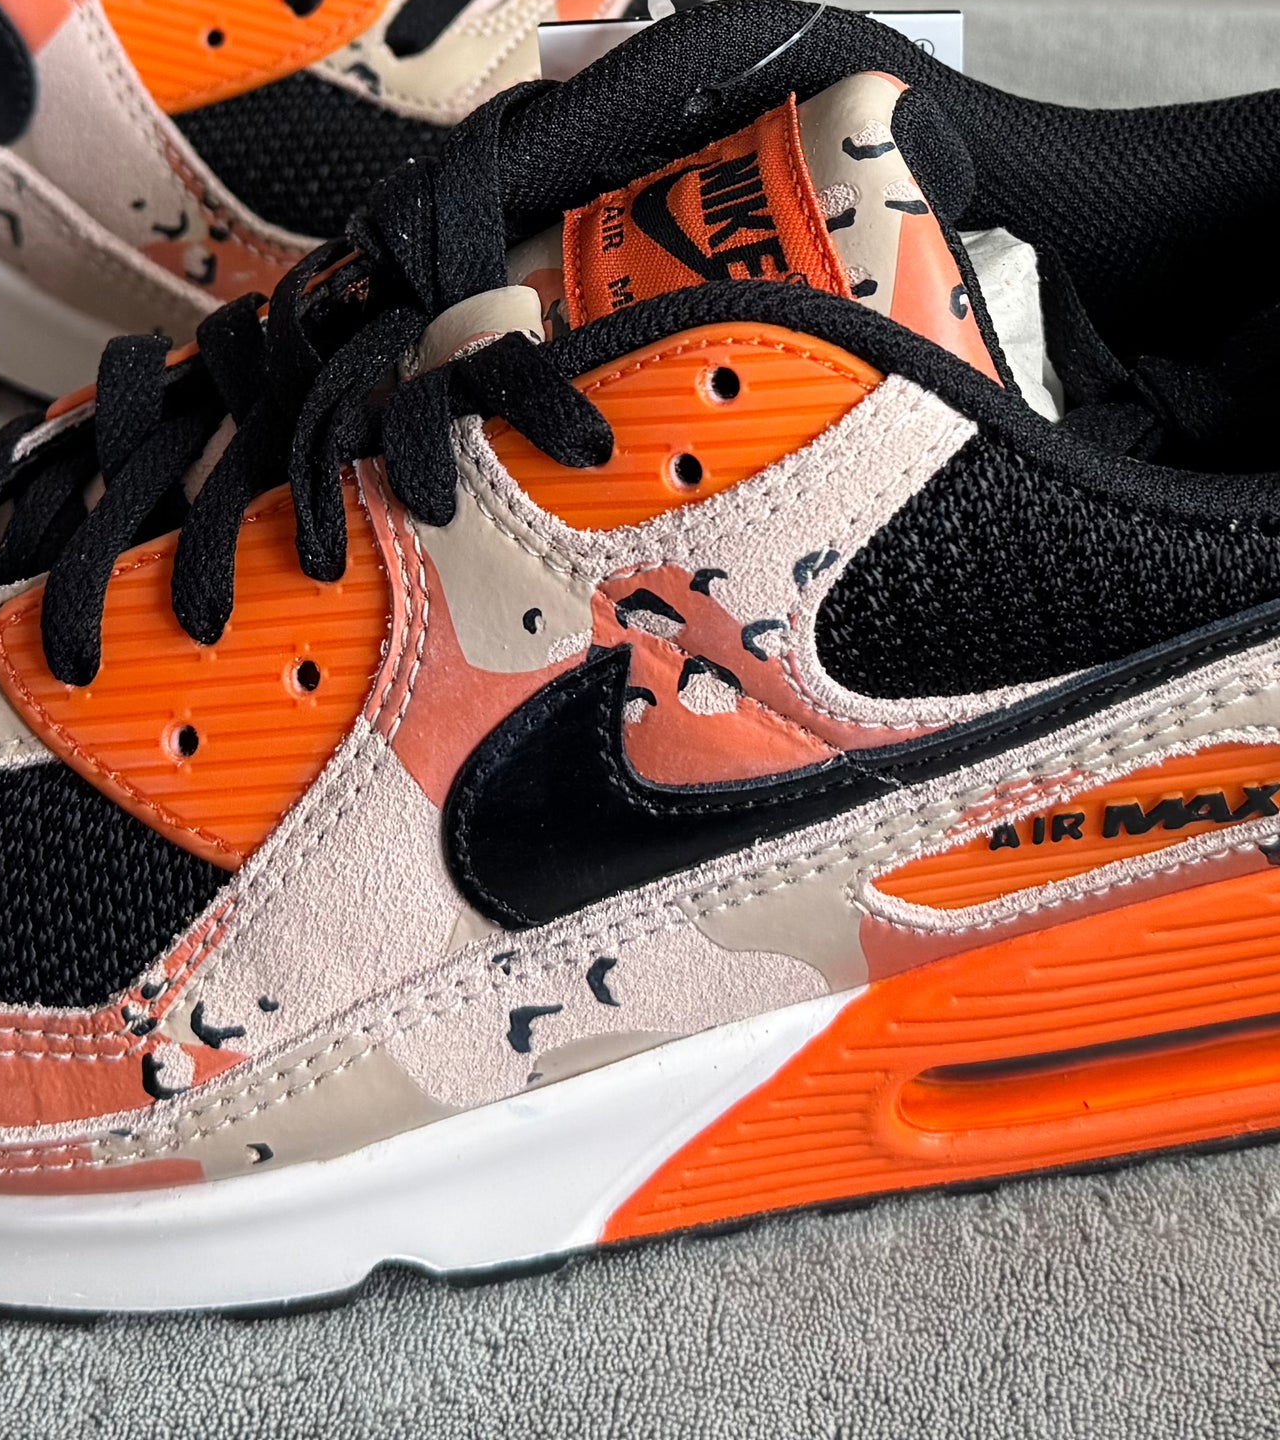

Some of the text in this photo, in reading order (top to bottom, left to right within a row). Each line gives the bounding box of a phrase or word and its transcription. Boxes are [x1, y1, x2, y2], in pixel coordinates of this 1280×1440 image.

[601, 207, 625, 252] AIR
[699, 151, 791, 281] NIKE
[990, 811, 1086, 851] AIR
